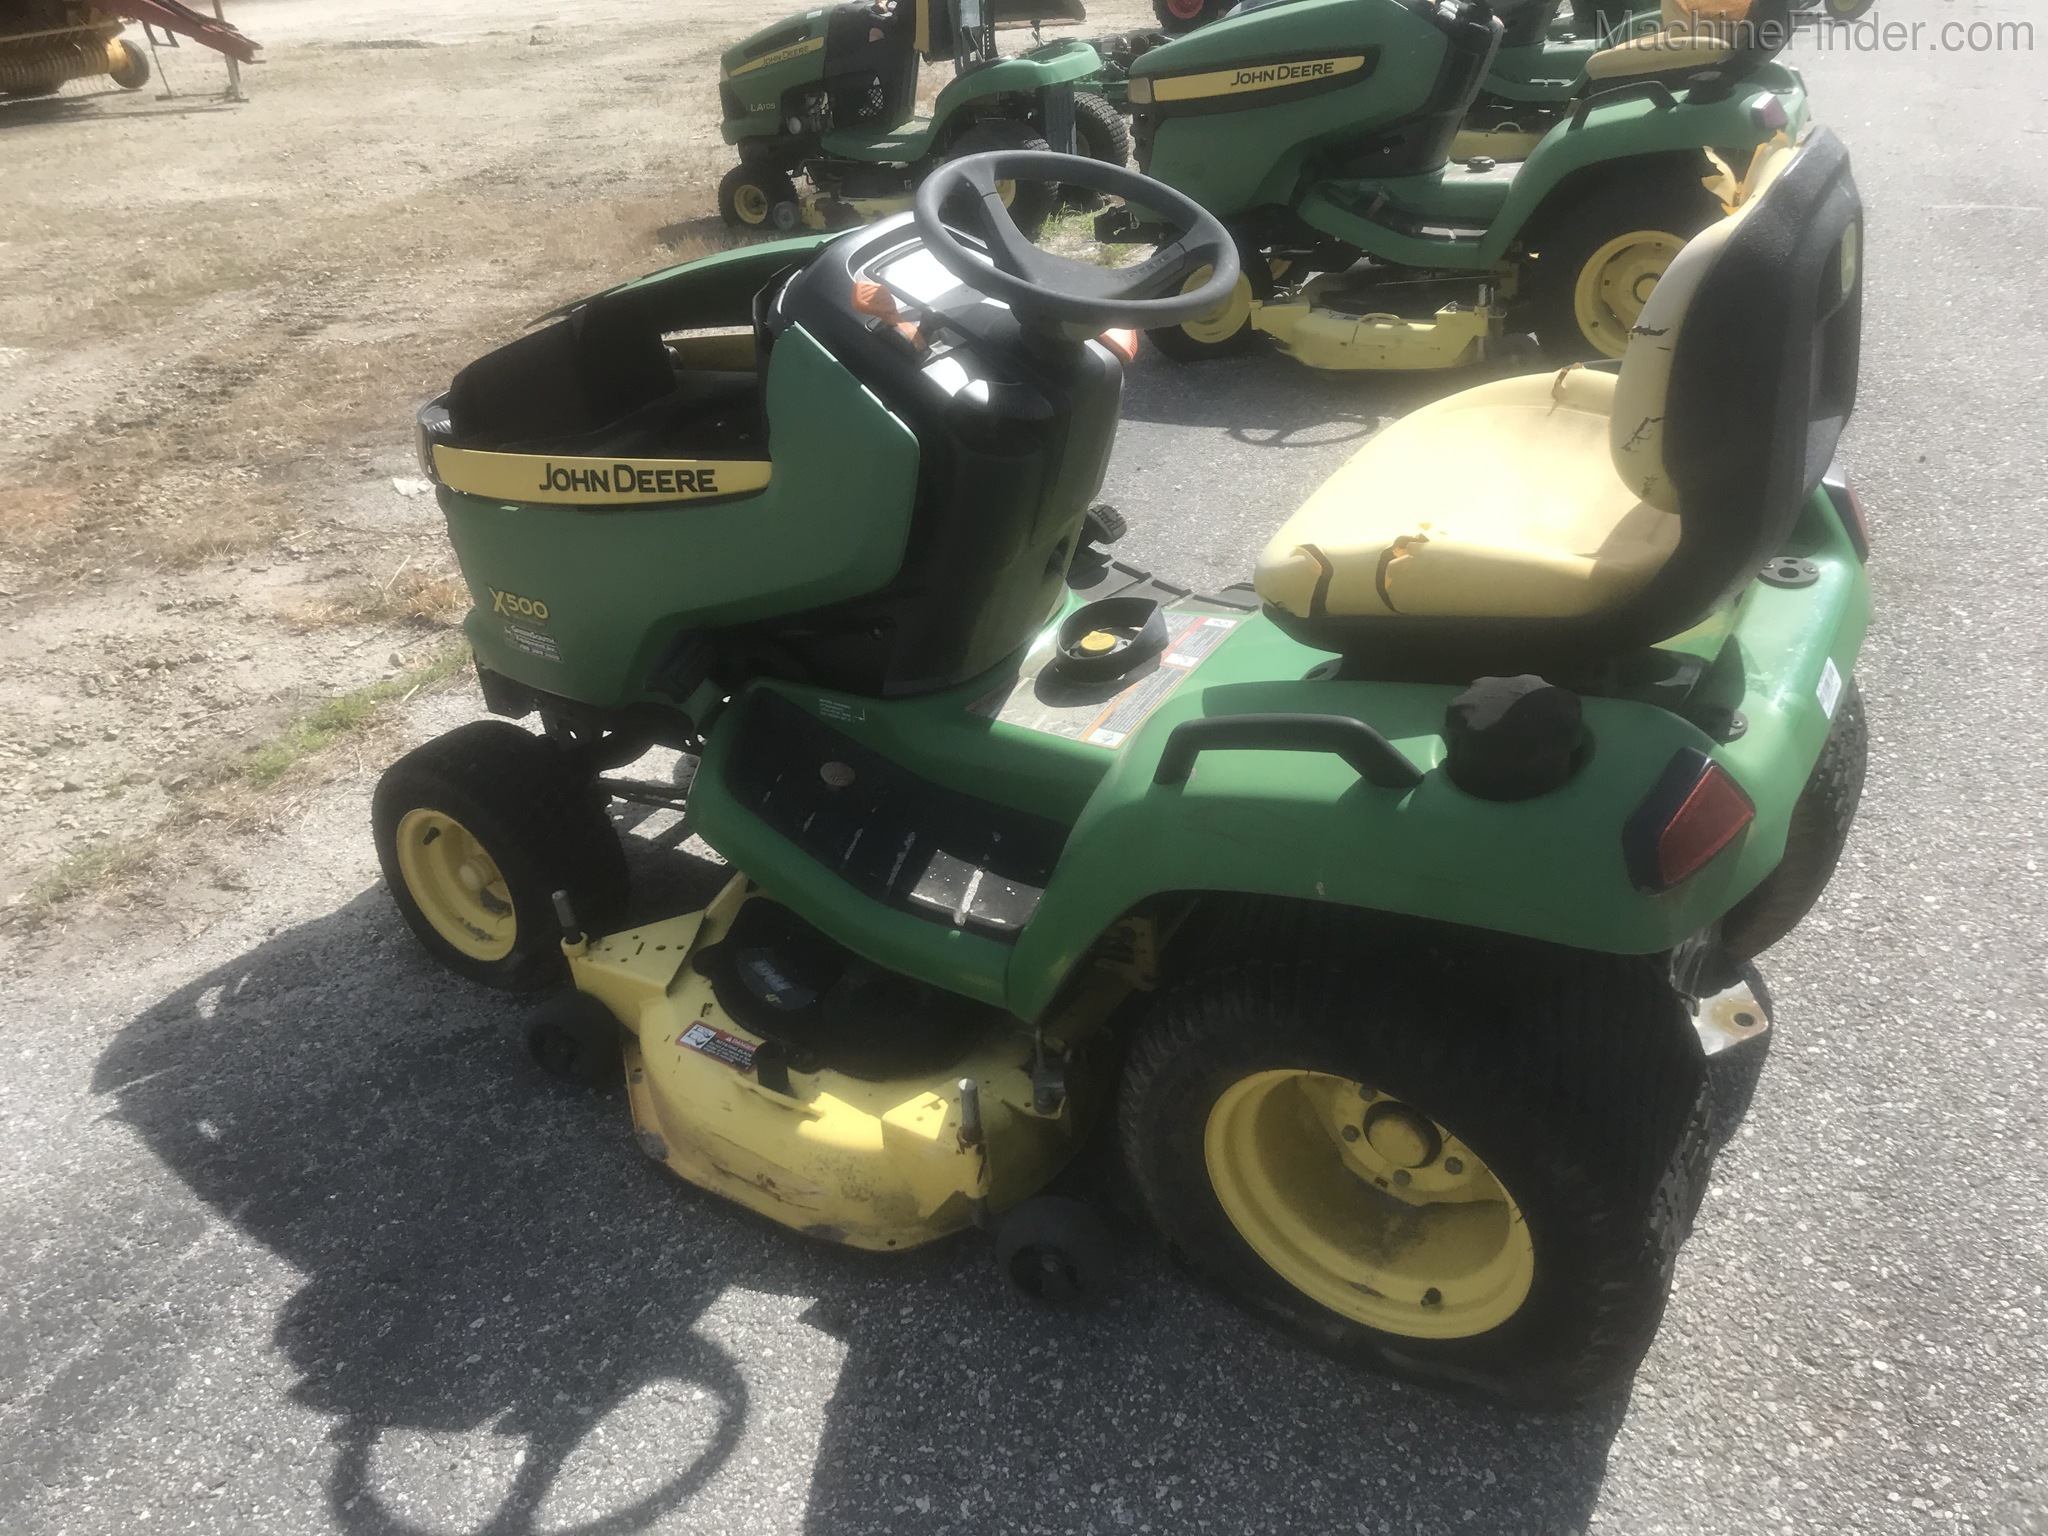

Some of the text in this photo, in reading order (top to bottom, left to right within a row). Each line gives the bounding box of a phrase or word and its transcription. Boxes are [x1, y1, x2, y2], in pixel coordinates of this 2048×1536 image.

[761, 45, 809, 68] JOHN DEERE
[1231, 62, 1334, 86] JOHN DEERE
[750, 103, 776, 112] LA105
[539, 463, 718, 493] JOHN DEERE
[487, 586, 549, 619] X500
